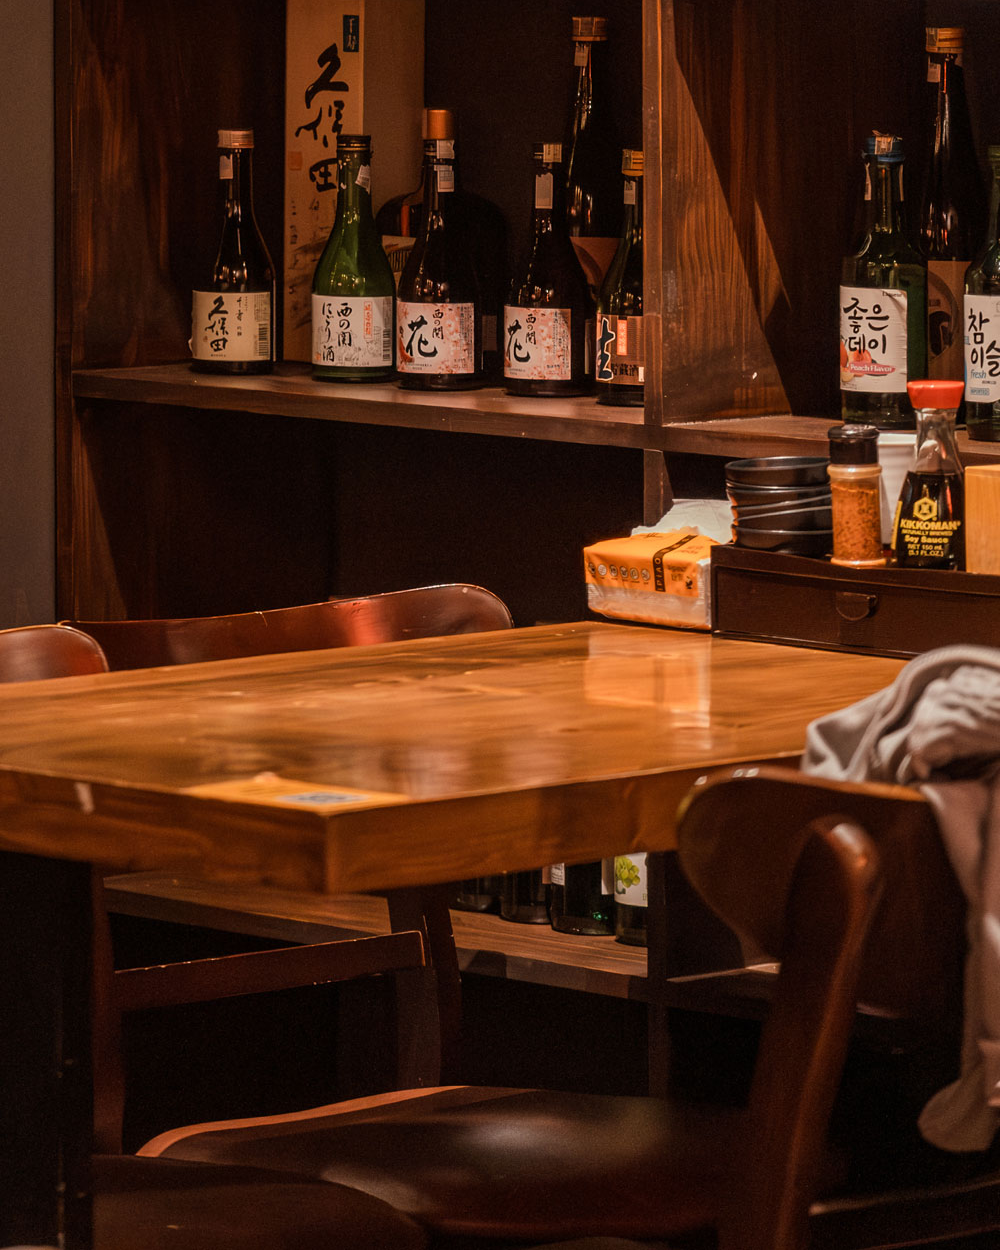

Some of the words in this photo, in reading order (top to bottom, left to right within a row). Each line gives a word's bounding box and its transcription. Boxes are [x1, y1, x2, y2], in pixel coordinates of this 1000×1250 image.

[204, 295, 229, 352] 久保田
[843, 297, 890, 334] 좋은
[968, 308, 990, 345] 참
[405, 315, 438, 358] 花
[848, 333, 887, 355] 데이
[970, 368, 987, 379] fresh
[900, 519, 958, 530] KIKKOMAN
[904, 535, 919, 543] Soy
